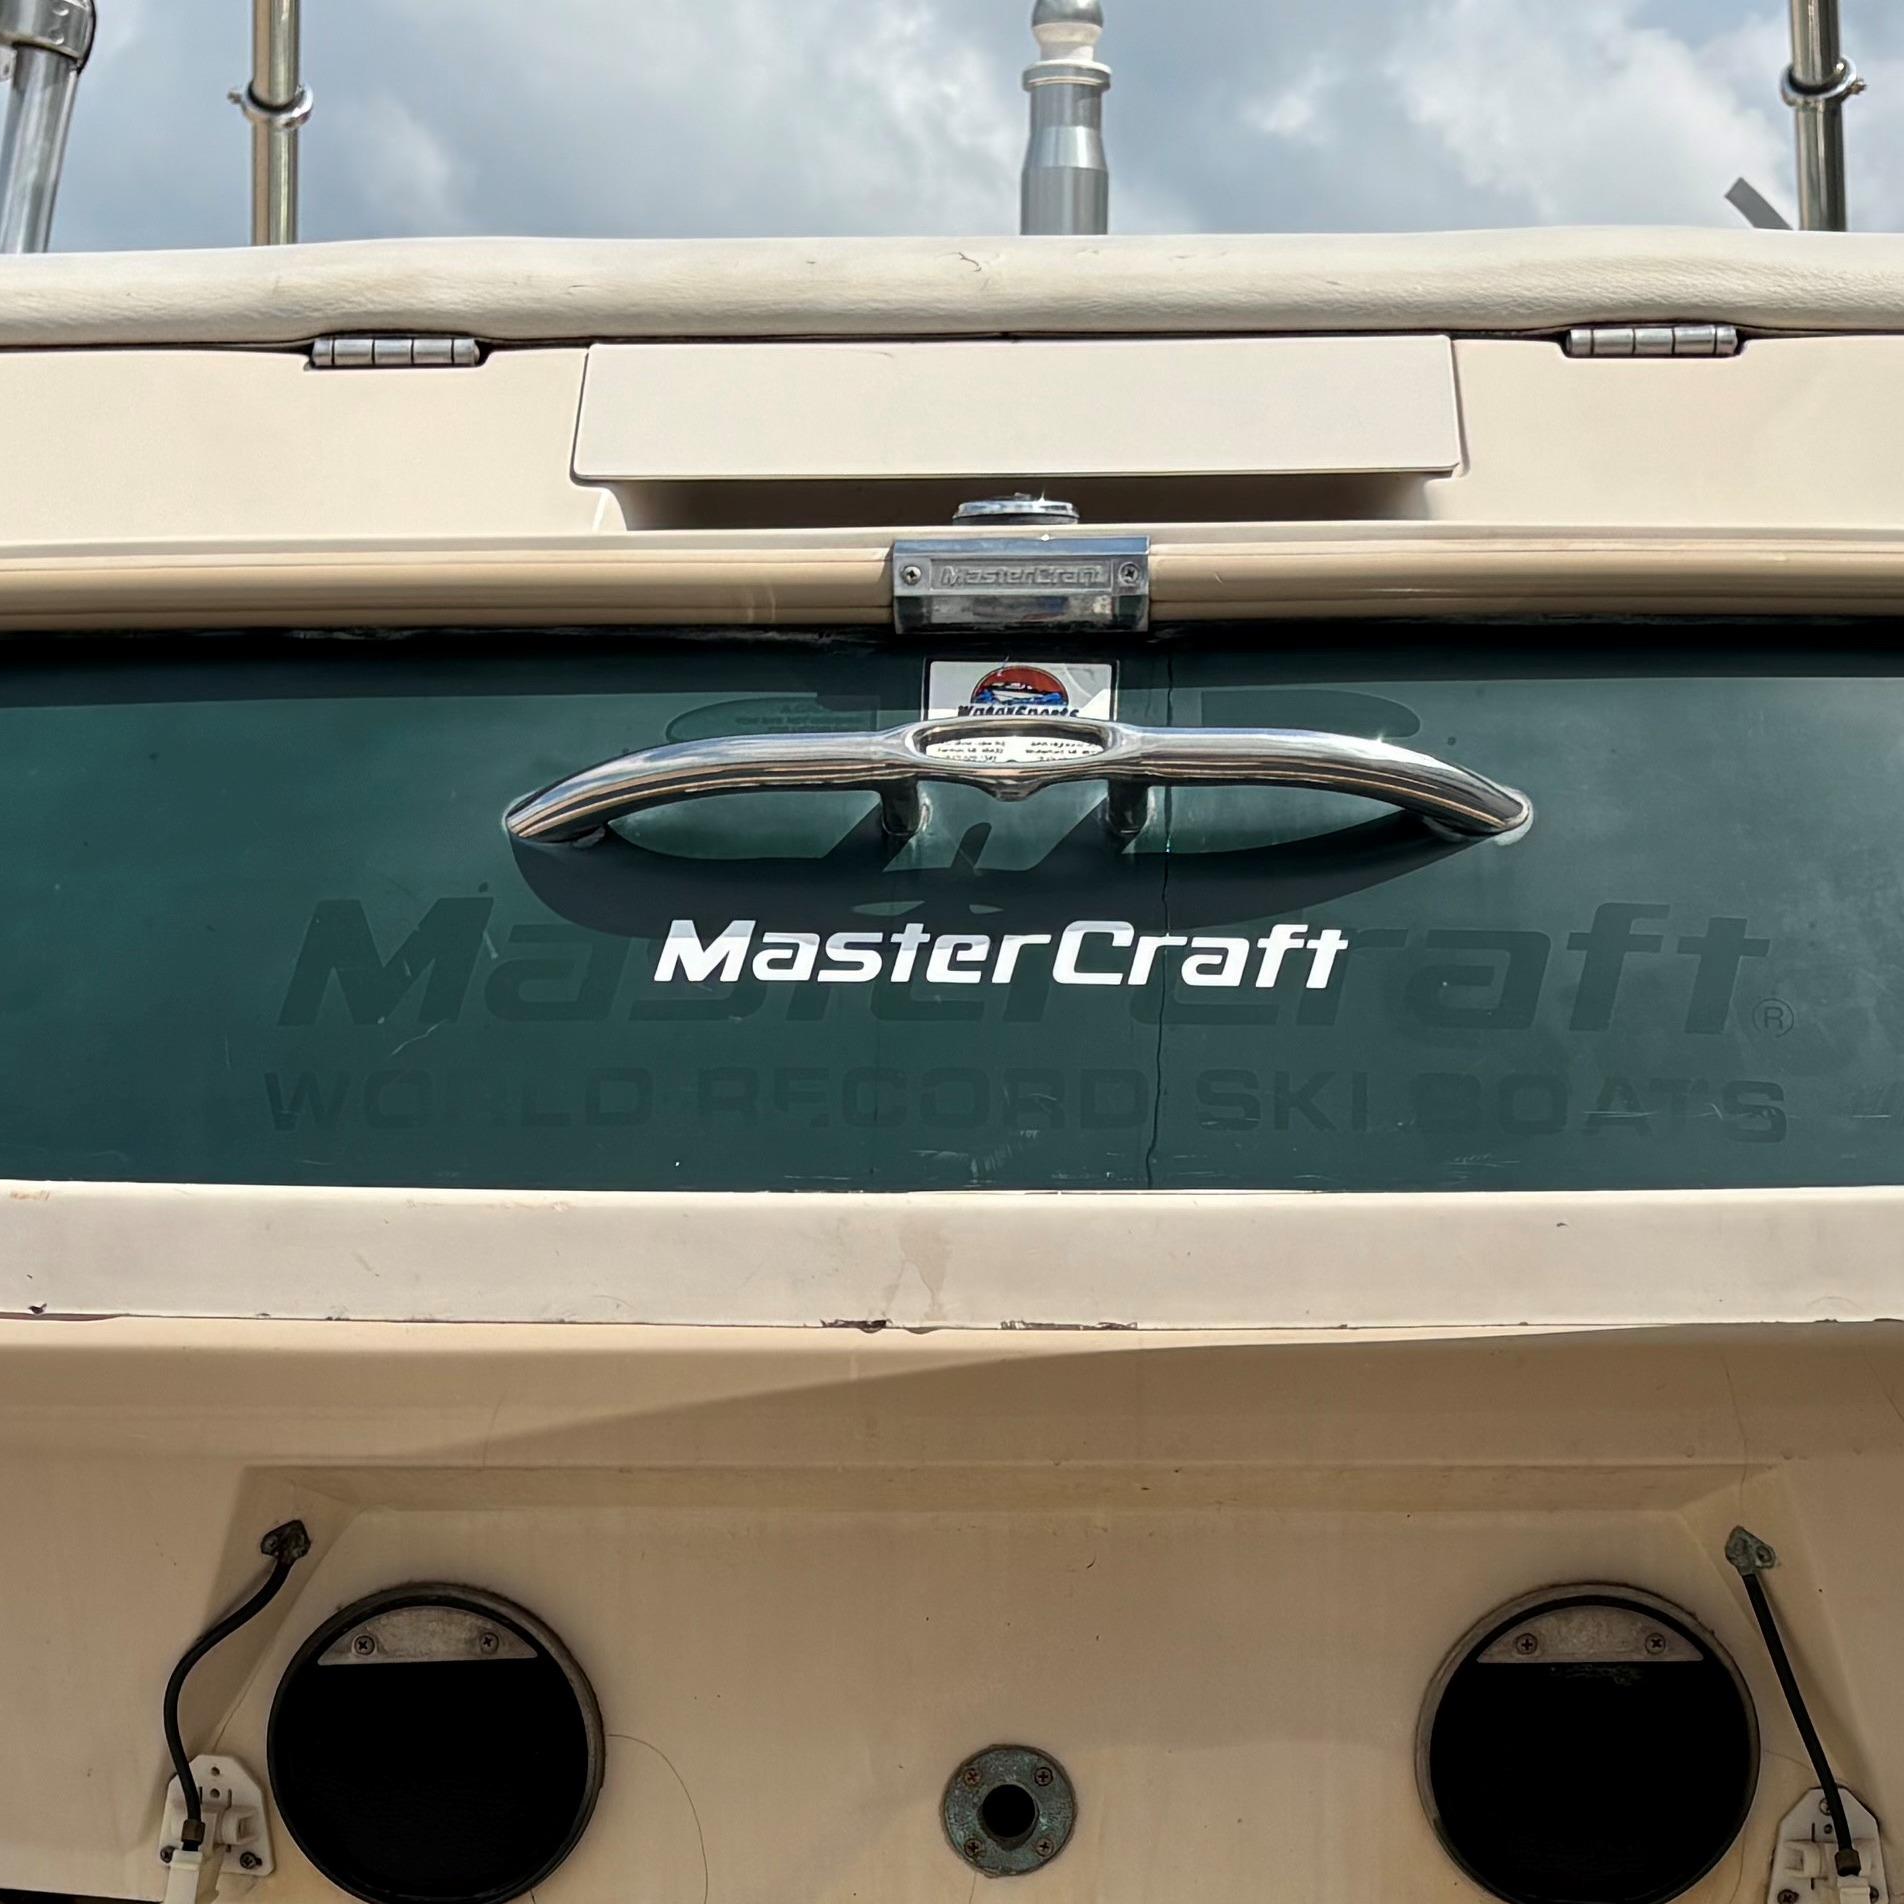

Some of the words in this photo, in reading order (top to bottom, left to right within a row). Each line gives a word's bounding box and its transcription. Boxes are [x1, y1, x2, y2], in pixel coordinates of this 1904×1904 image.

[940, 565, 1104, 587] MasterCraft
[653, 919, 1349, 989] MasterCraft
[697, 1065, 1150, 1131] RECORD
[1199, 1068, 1368, 1132] SKI
[1410, 1071, 1788, 1143] BOATS
